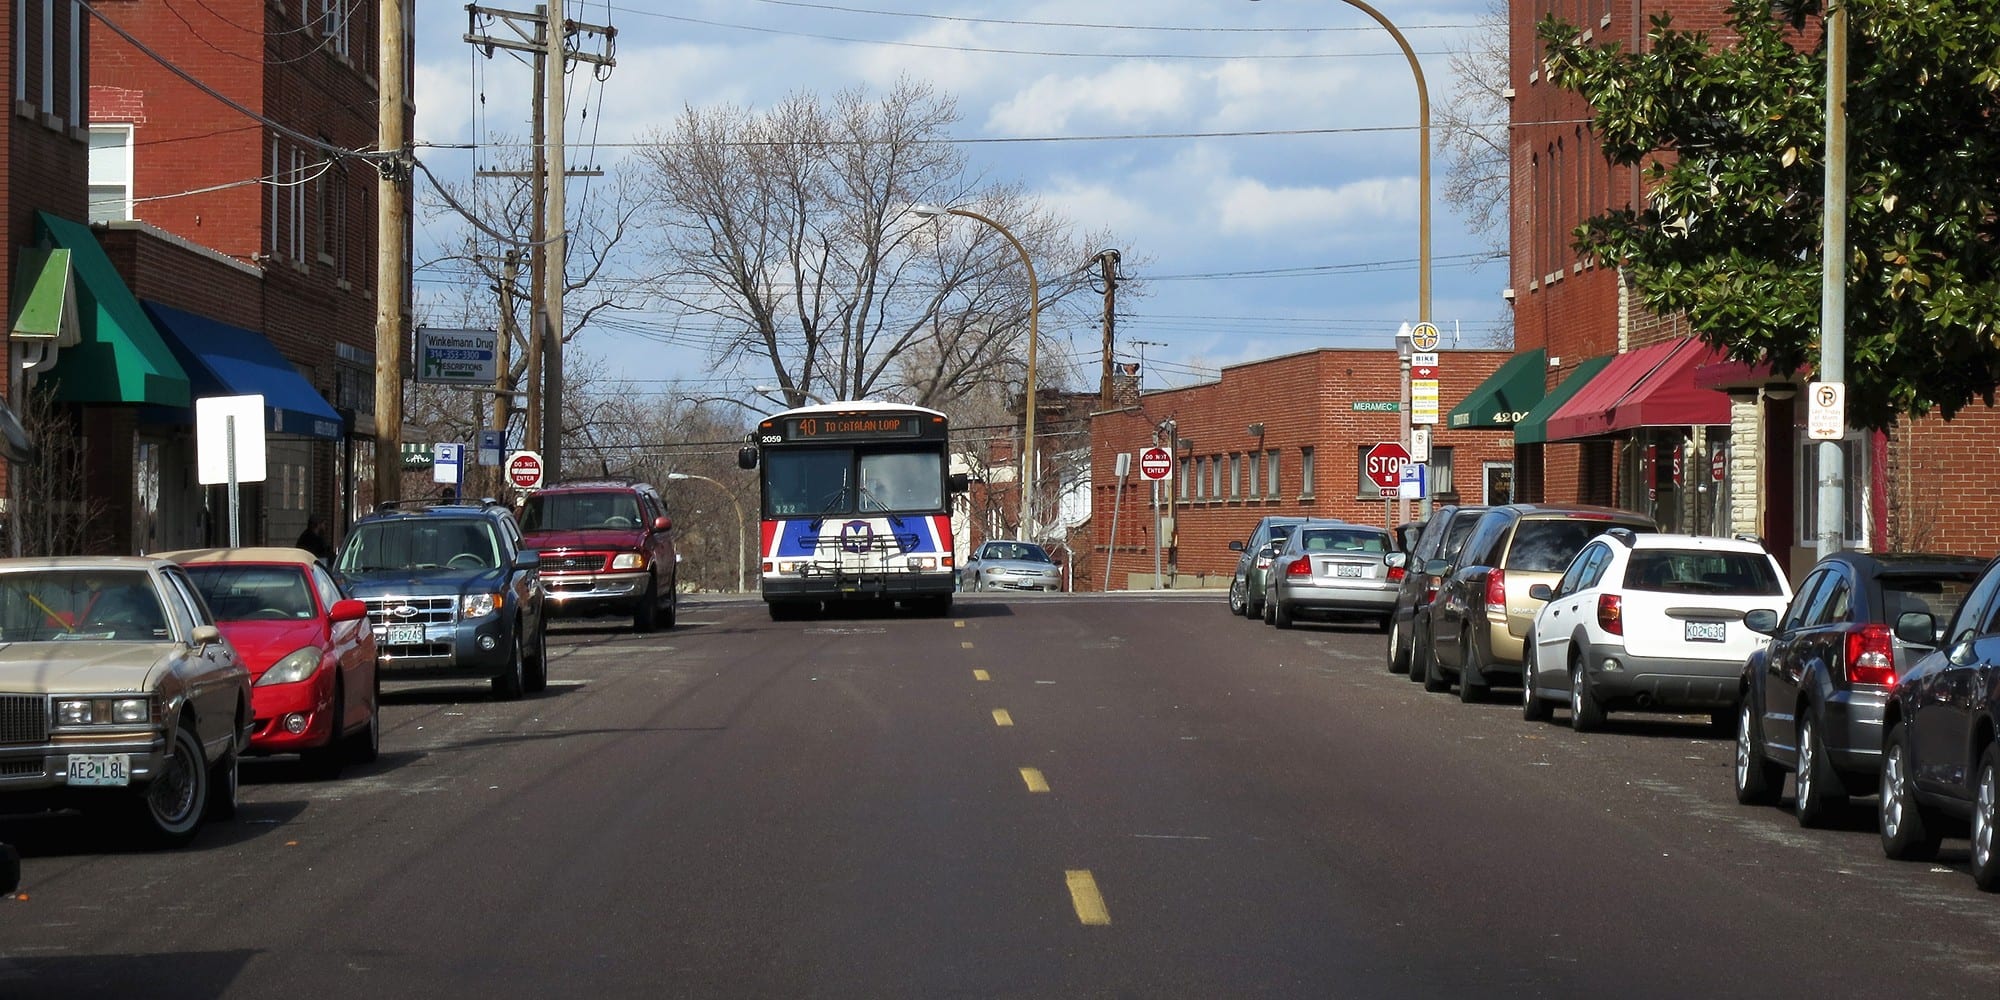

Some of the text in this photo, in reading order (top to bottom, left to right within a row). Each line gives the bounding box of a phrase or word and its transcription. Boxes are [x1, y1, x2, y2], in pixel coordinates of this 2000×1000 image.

[427, 335, 493, 351] Winkelmann Drug
[1353, 402, 1392, 411] MERAMEC
[800, 419, 900, 436] 40 TO CATALAN LOOP
[405, 454, 430, 463] coffee
[776, 505, 796, 514] 322
[70, 762, 126, 779] AE2 L8L
